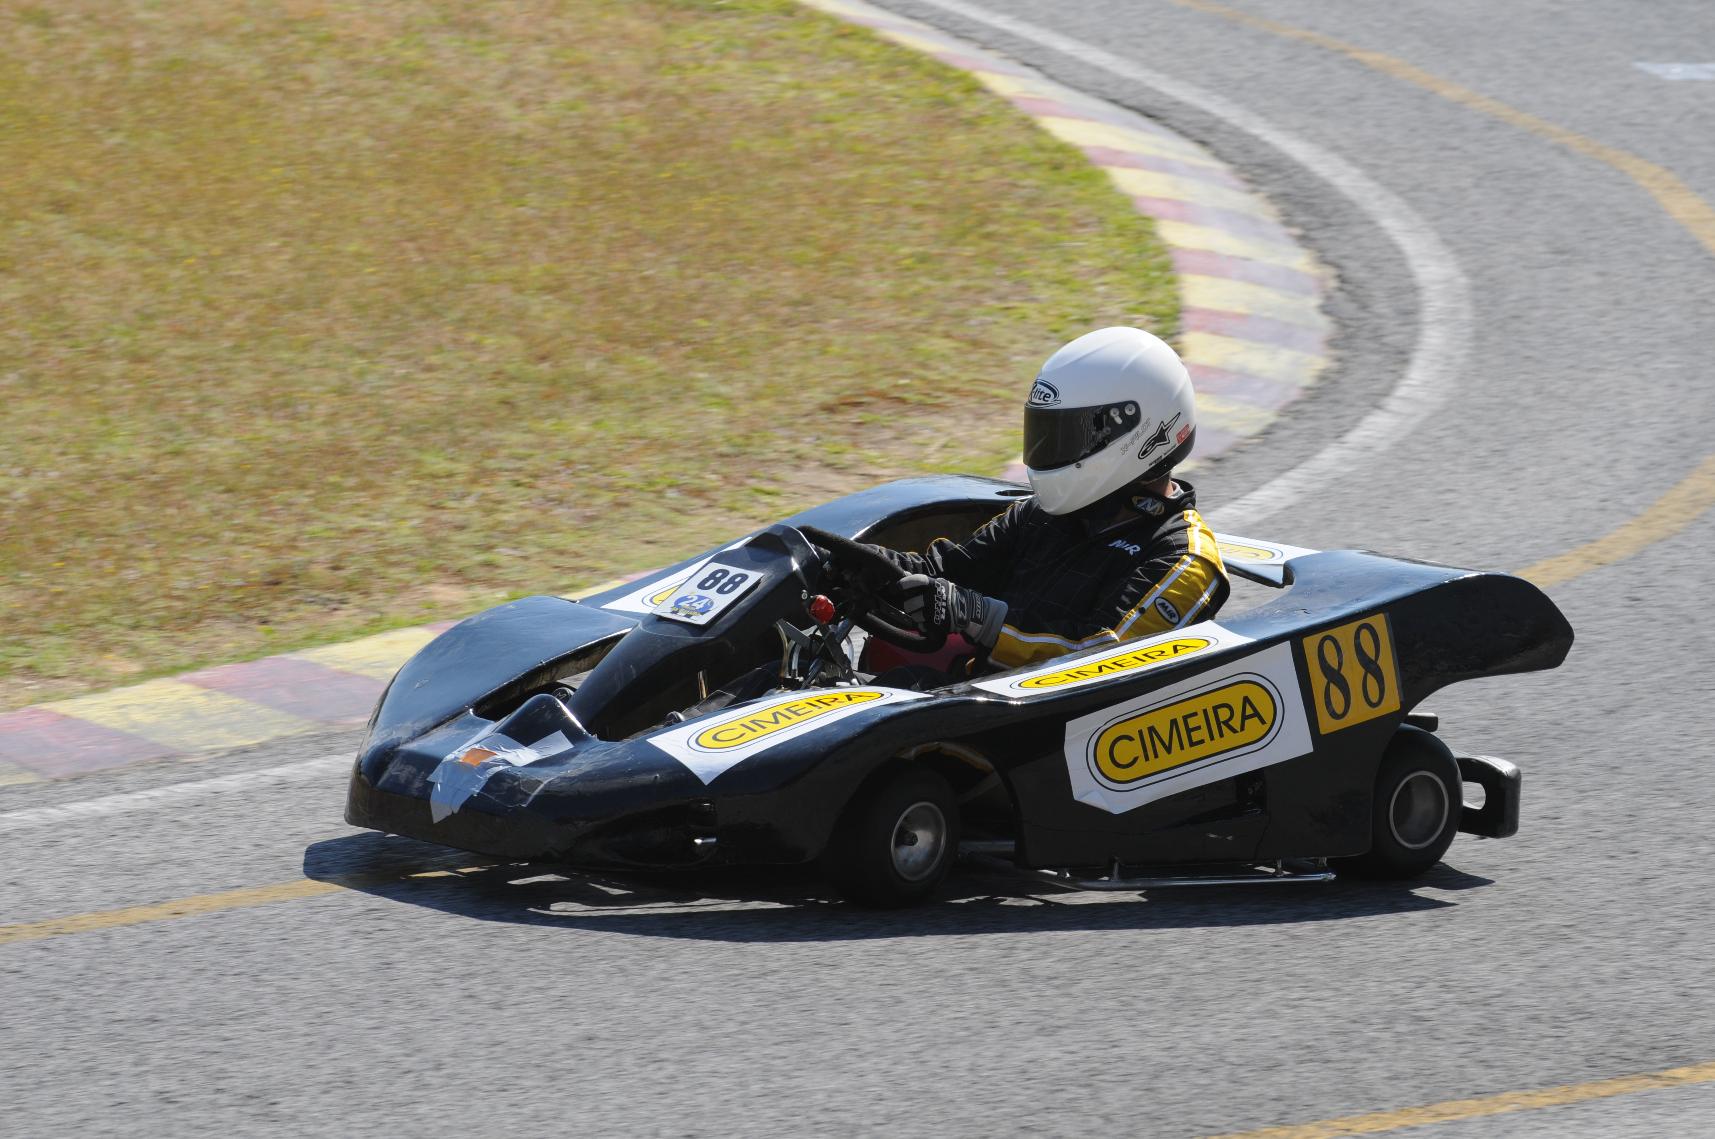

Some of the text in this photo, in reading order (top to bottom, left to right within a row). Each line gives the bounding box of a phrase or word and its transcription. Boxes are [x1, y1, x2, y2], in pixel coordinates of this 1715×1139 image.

[697, 569, 749, 594] 88
[1035, 644, 1202, 686] CIMEIRA
[1317, 622, 1386, 721] 88
[711, 692, 876, 743] CIMEIRA
[1108, 695, 1268, 769] CIMEIRA
